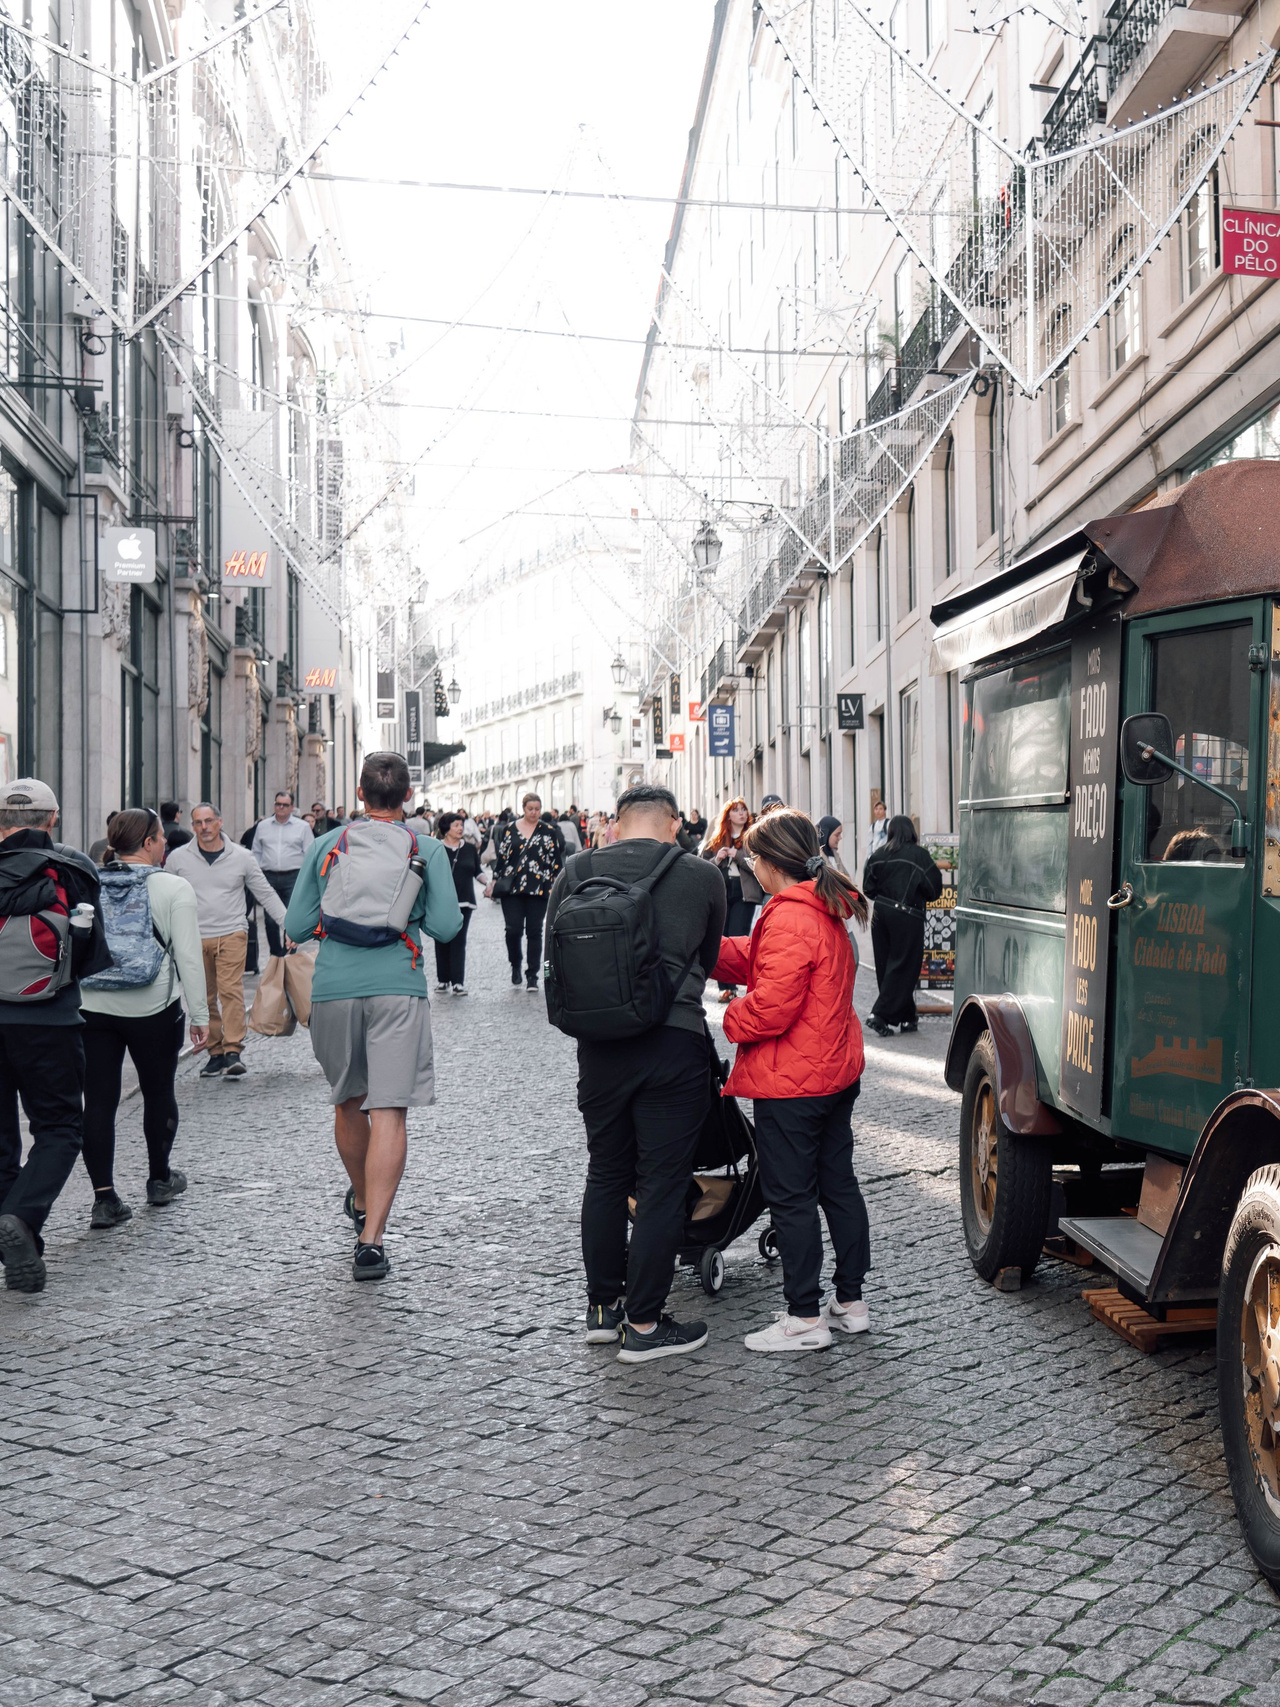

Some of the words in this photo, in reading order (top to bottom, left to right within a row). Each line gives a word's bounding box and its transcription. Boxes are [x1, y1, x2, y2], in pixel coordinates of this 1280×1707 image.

[1243, 238, 1268, 253] DO
[1235, 253, 1277, 272] PÊLO
[114, 562, 146, 570] Premium
[116, 569, 143, 577] Partner
[225, 550, 268, 578] H&M
[1087, 647, 1101, 676] MAIS
[305, 667, 338, 688] H&M
[654, 701, 662, 734] HAIR
[1080, 681, 1108, 739] FADO
[1083, 747, 1100, 775] MENOS
[1075, 782, 1108, 845] PREÇO
[926, 899, 956, 908] ERCING
[1080, 878, 1093, 906] MORE
[1157, 902, 1206, 935] LISBOA
[1072, 914, 1097, 972] FADO
[1134, 936, 1175, 969] Cidade
[1177, 941, 1192, 971] de
[1194, 942, 1227, 976] Fado
[1076, 977, 1088, 1006] LESS
[1067, 1010, 1094, 1074] PRICE
